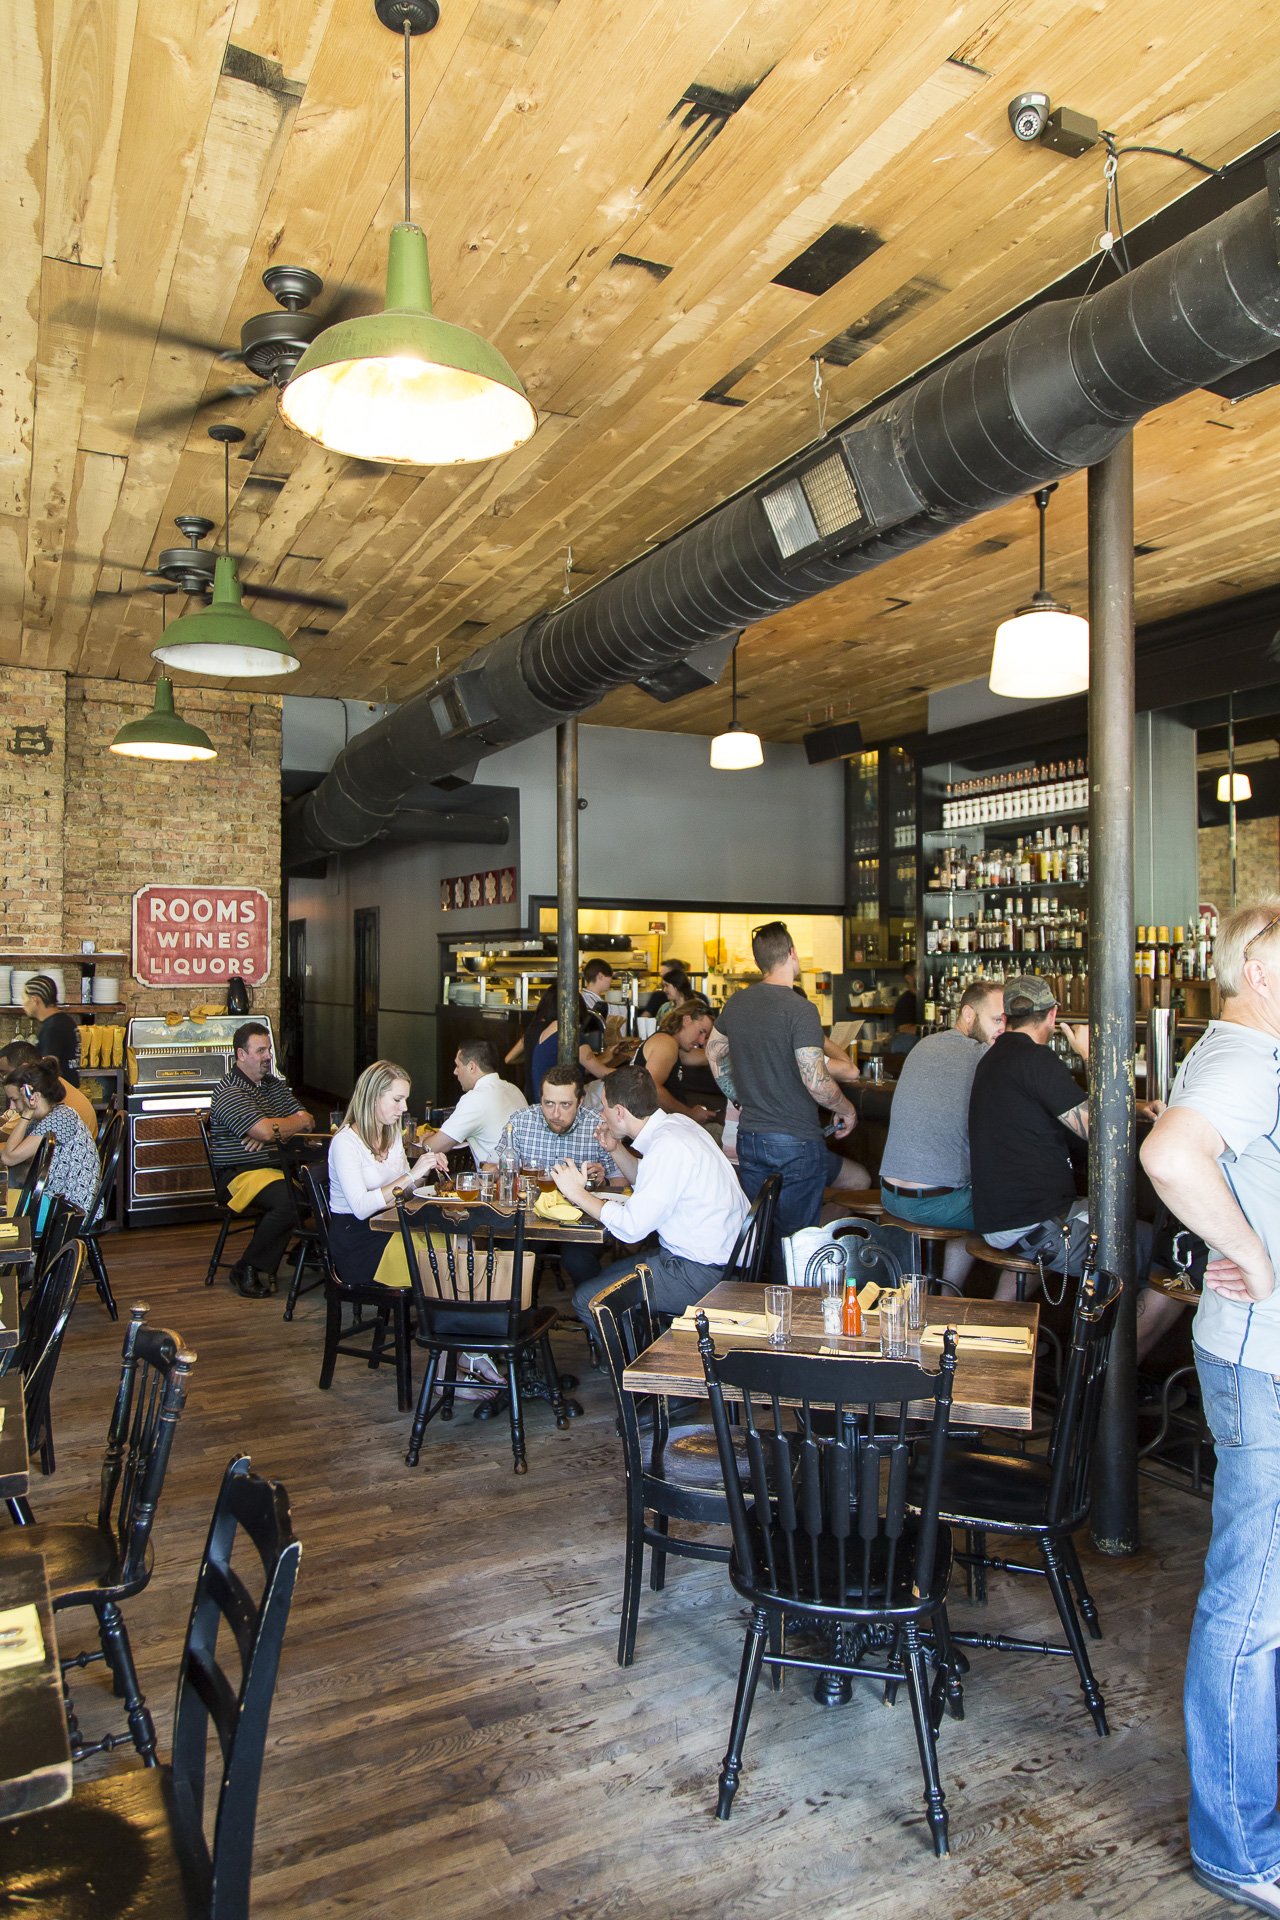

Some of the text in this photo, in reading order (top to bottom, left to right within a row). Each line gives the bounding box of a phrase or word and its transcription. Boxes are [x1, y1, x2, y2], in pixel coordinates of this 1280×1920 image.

[150, 897, 256, 924] ROOMS
[156, 931, 250, 949] WINES
[150, 957, 255, 976] LIQUORS
